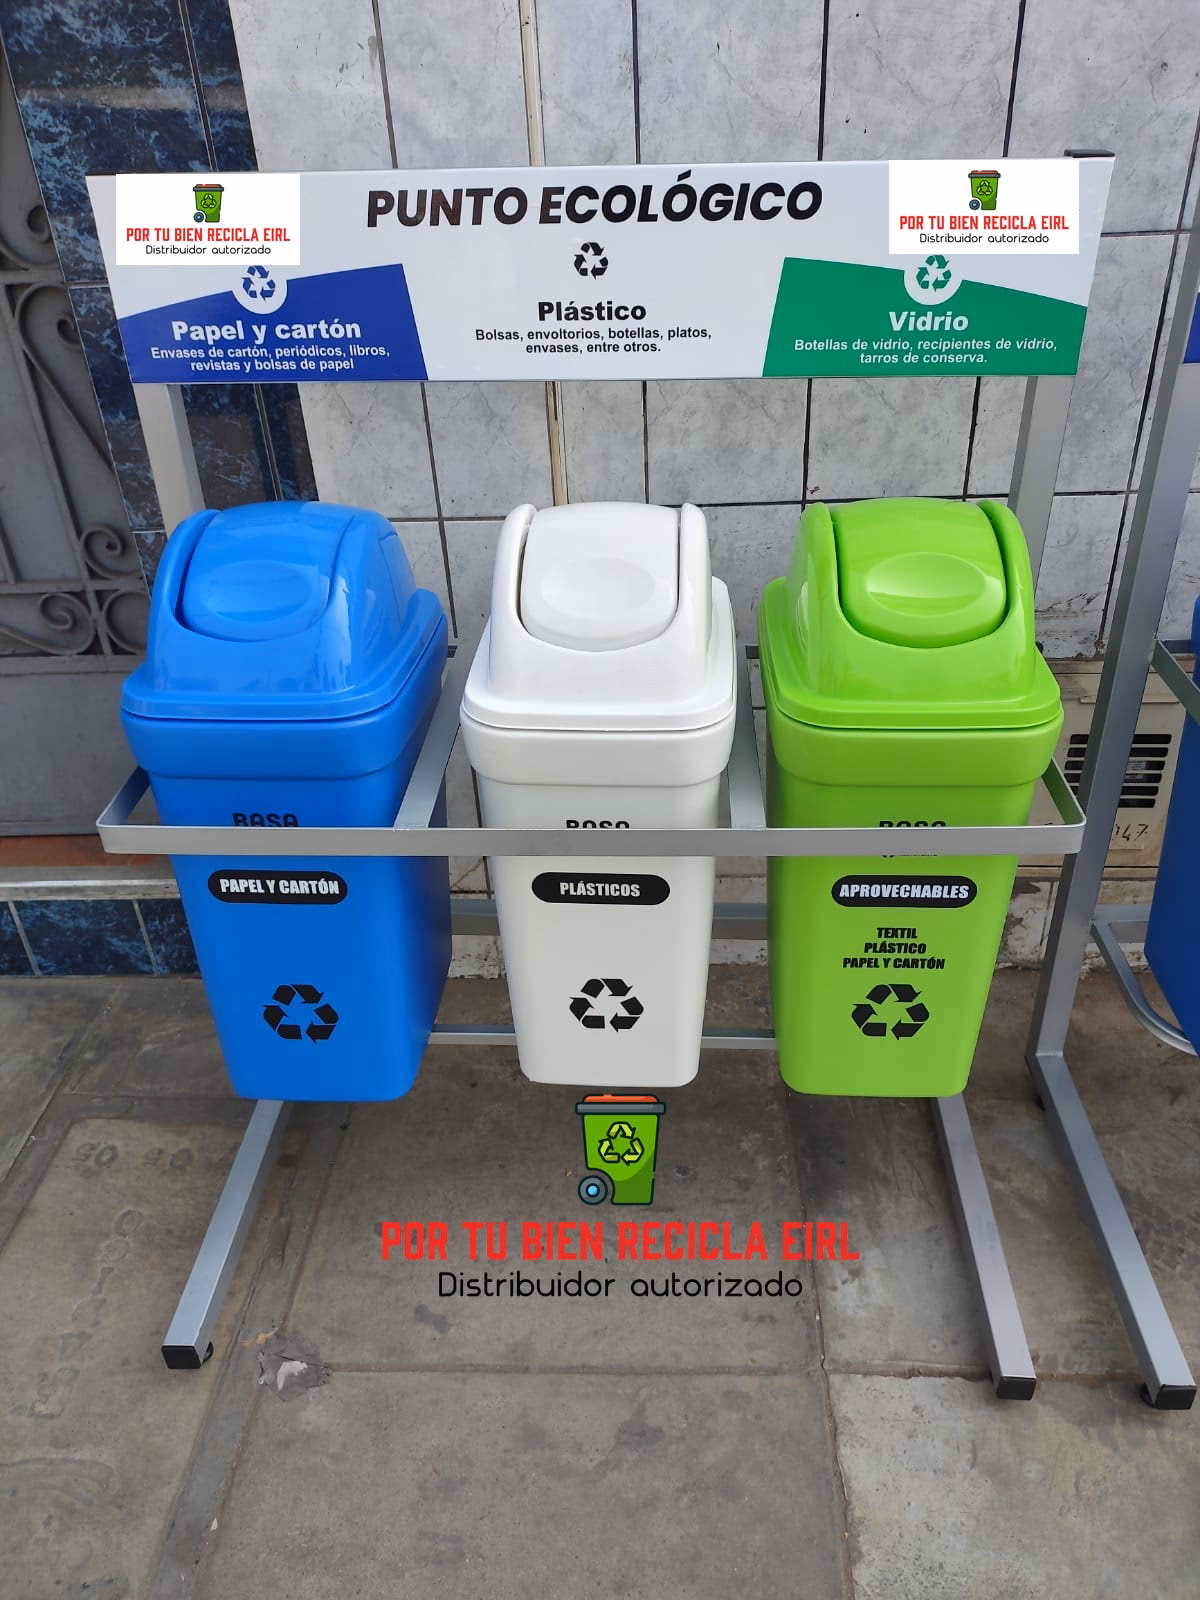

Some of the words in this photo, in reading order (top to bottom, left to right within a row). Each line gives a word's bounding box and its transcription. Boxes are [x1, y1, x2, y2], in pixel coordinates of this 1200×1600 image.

[367, 187, 528, 228] PUNTO
[538, 169, 823, 225] ECOLÓGICO
[538, 300, 647, 322] Plástico
[889, 311, 969, 332] Vidrio
[171, 320, 245, 345] Papel
[251, 324, 267, 345] y
[275, 318, 362, 339] cartón
[475, 328, 524, 342] Bolsas,
[527, 327, 604, 341] envoltorios,
[608, 327, 664, 341] botellas,
[667, 326, 712, 341] platos,
[151, 346, 205, 359] Envases
[208, 346, 224, 358] de
[227, 346, 273, 361] cartón,
[275, 344, 347, 360] periódicos,
[349, 344, 390, 358] libros,
[525, 343, 583, 356] envases,
[587, 343, 620, 354] entre
[623, 342, 661, 354] otros.
[794, 339, 848, 351] Botellas
[852, 339, 868, 351] de
[872, 339, 913, 352] vidrio,
[917, 338, 991, 352] recipientes
[995, 338, 1012, 350] de
[1016, 338, 1057, 352] vidrio,
[191, 359, 241, 372] revistas
[244, 360, 251, 373] y
[254, 358, 297, 371] bolsas
[300, 358, 316, 371] de
[319, 357, 355, 372] papel
[860, 353, 899, 364] tarros
[903, 352, 919, 364] de
[922, 352, 988, 364] conserva.
[219, 878, 265, 894] PAPEL
[265, 879, 276, 894] Y
[278, 877, 340, 895] CARTÓN
[559, 880, 641, 897] PLÁSTICOS
[839, 884, 970, 899] APROVECHABLES
[876, 927, 918, 939] TEXTIL
[863, 940, 927, 954] PLÁSTICO
[842, 957, 880, 969] PAPEL
[882, 957, 891, 969] Y
[892, 956, 946, 970] CARTÓN
